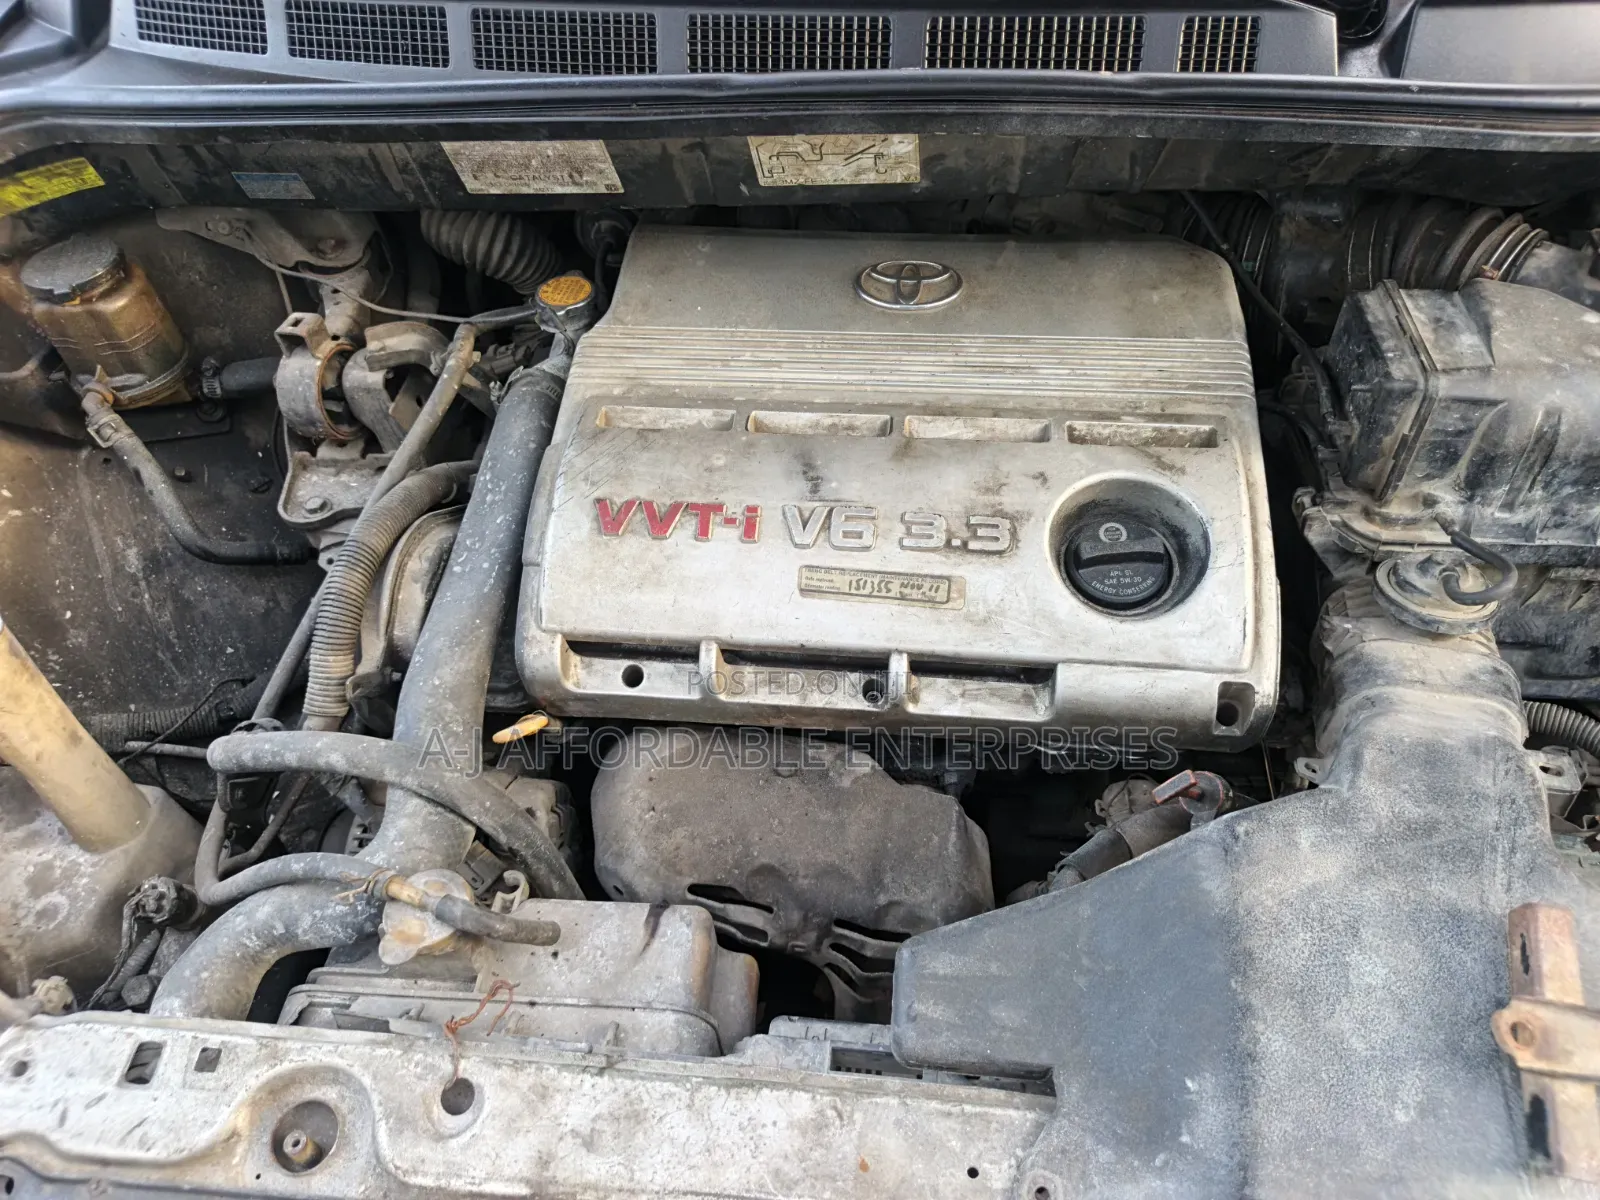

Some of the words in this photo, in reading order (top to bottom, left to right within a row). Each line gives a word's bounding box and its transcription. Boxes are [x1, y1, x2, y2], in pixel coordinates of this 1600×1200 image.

[593, 498, 763, 543] VVT-i
[781, 504, 880, 551] V6
[899, 510, 1017, 555] 3.3
[848, 577, 894, 595] 151355
[1091, 580, 1117, 594] ENERGY
[1120, 577, 1155, 595] CONSERVING
